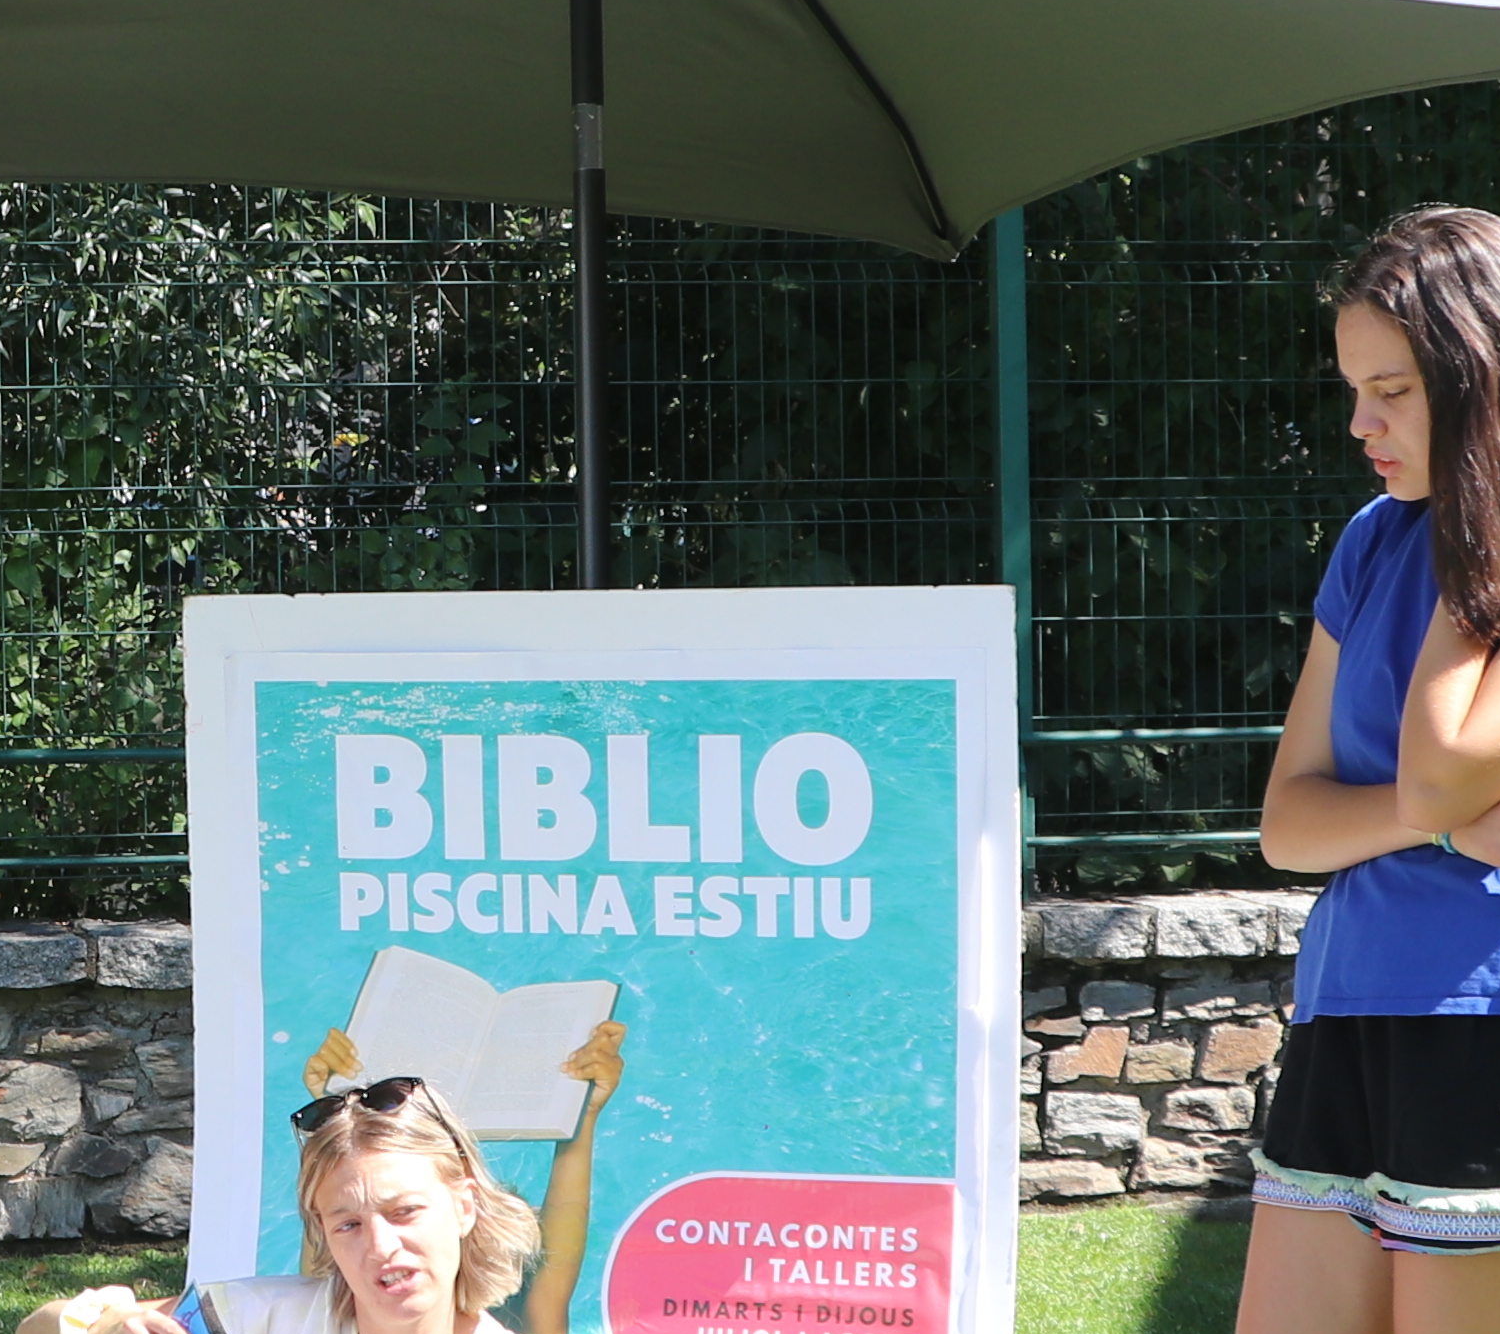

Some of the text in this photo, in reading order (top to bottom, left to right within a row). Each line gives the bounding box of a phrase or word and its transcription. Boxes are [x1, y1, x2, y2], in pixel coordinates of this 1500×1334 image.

[336, 732, 874, 866] BIBLIO
[339, 871, 873, 941] PISCINA ESTIU
[655, 1218, 920, 1253] CONTACONTES
[743, 1257, 918, 1289] I TALLERS
[662, 1298, 915, 1328] DIMARTS I DIJOUS
